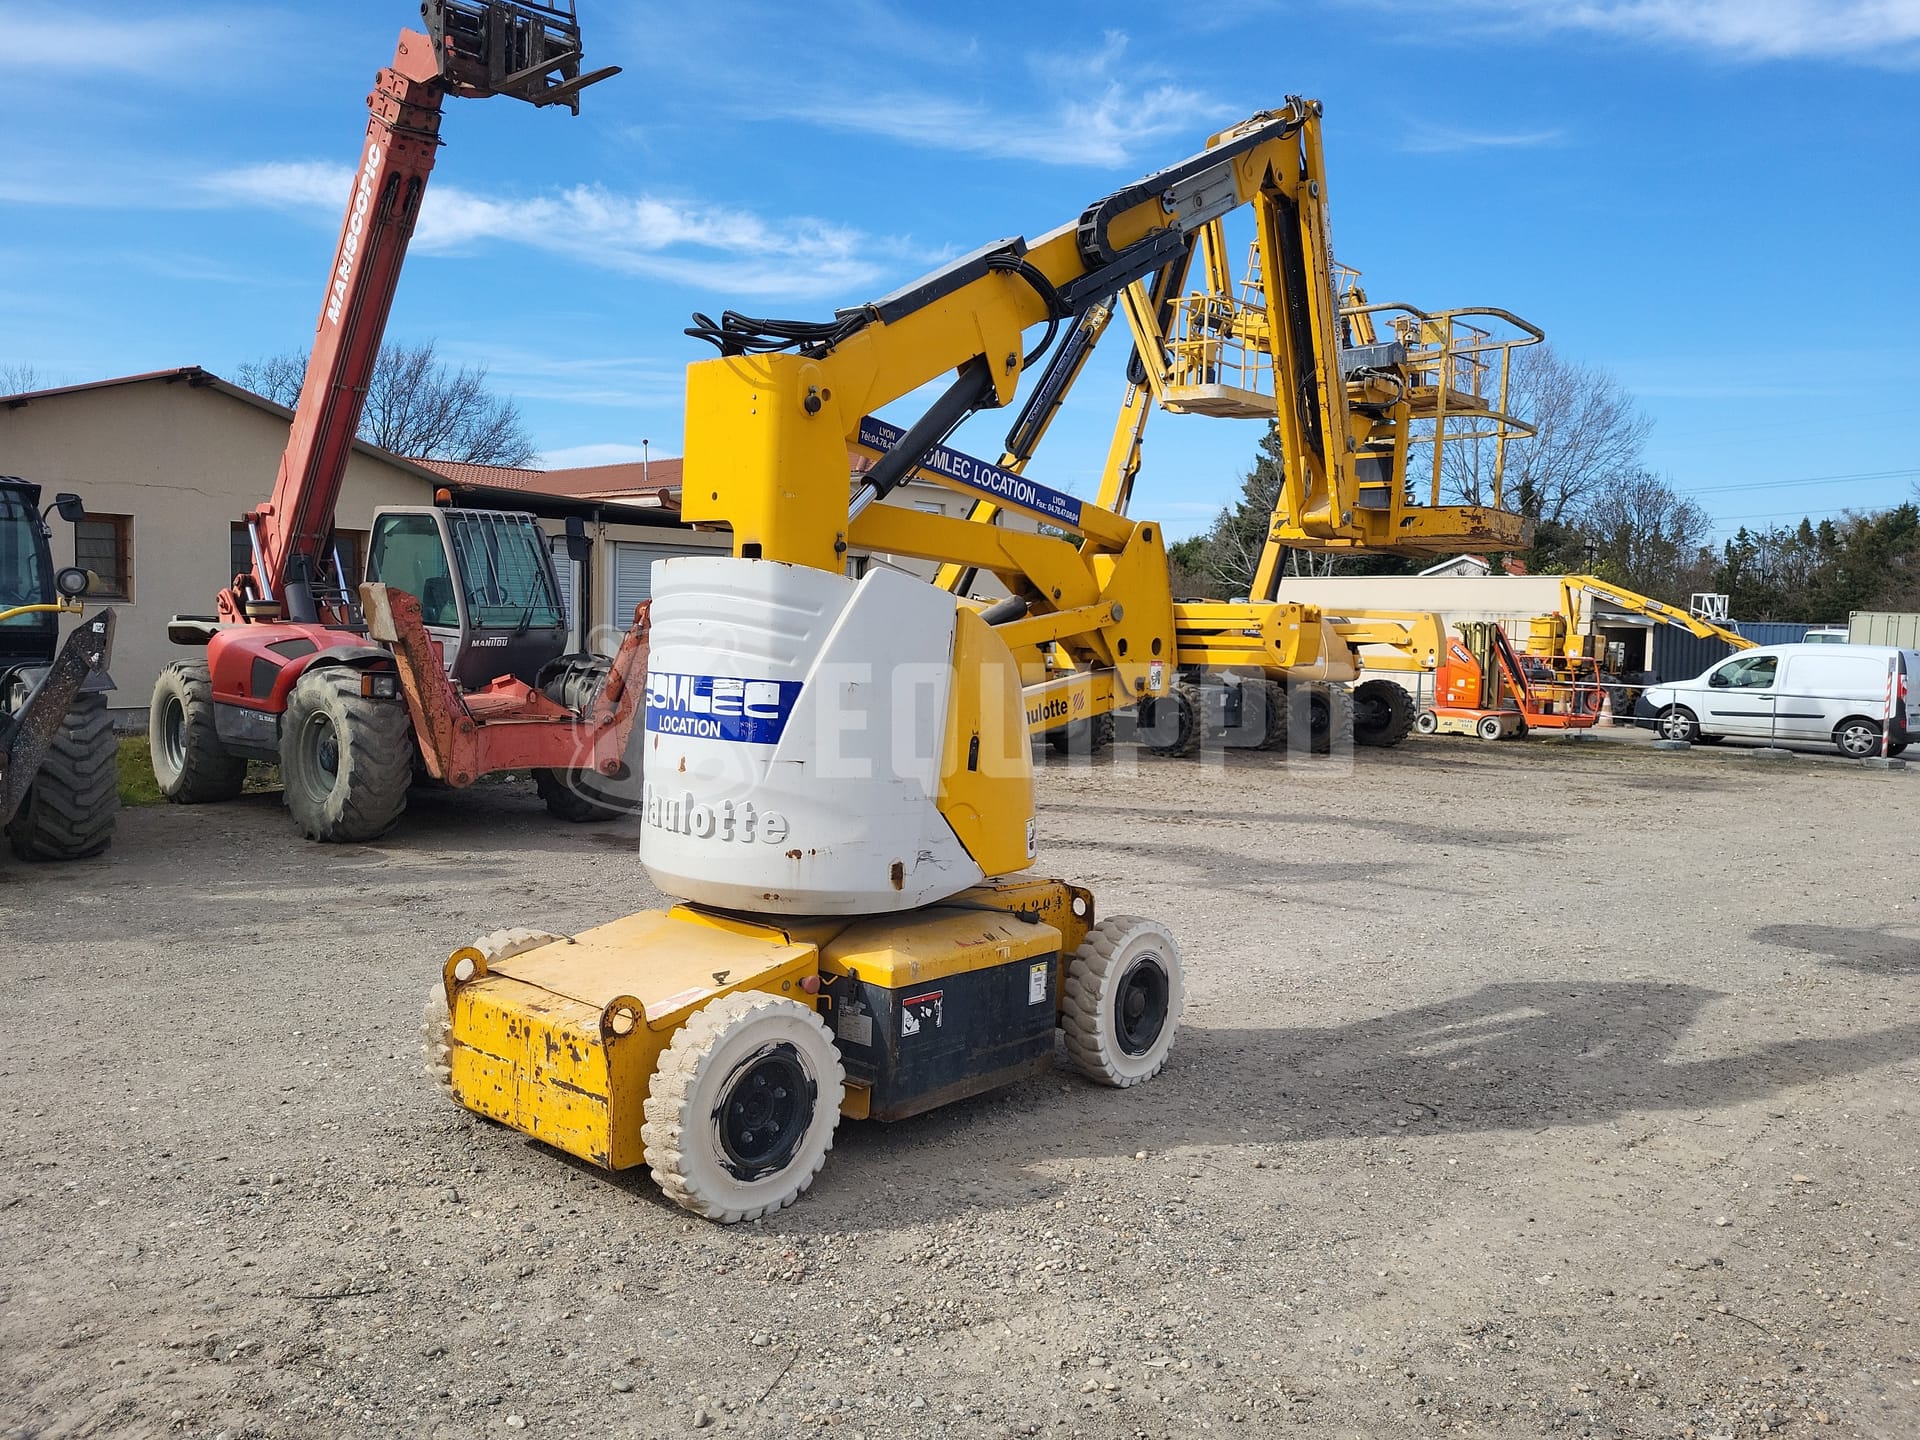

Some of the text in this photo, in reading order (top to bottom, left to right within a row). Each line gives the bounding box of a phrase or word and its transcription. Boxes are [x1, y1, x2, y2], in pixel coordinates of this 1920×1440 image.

[327, 143, 381, 326] MANISCOPIC
[879, 426, 896, 440] LYON
[973, 465, 1035, 504] LOCATION
[1052, 495, 1066, 507] LYON
[471, 636, 508, 647] MANITOU
[659, 715, 721, 738] LOCATION
